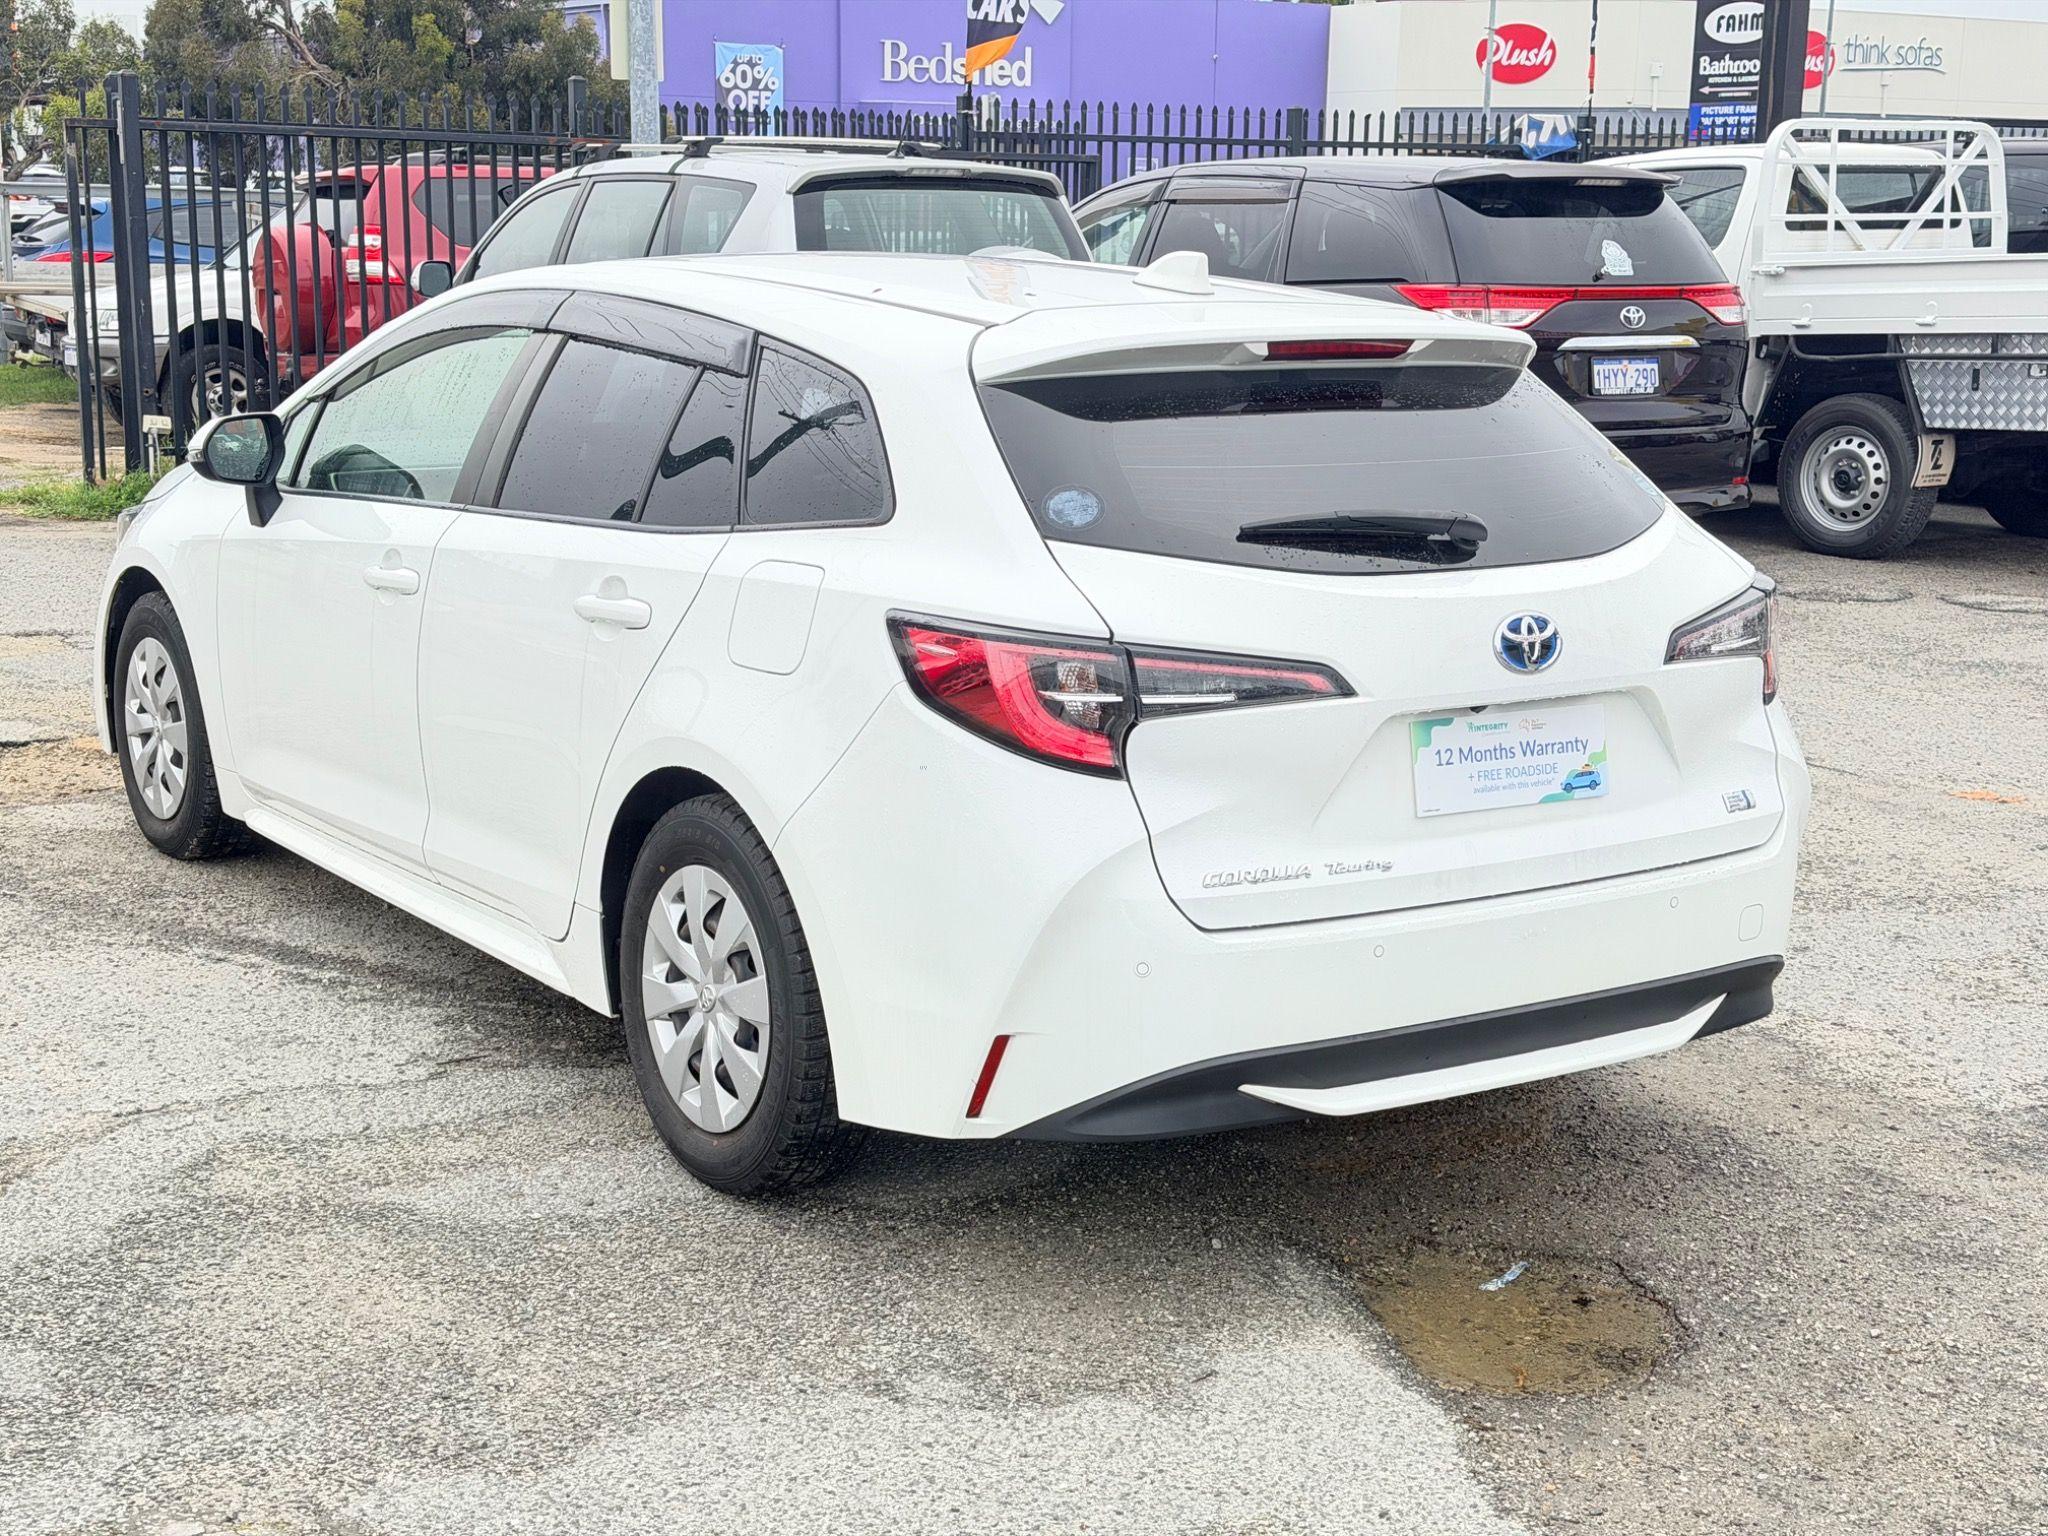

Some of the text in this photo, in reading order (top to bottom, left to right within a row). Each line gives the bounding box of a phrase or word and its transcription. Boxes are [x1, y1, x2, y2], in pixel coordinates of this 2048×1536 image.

[966, 0, 1030, 24] CARS
[736, 54, 764, 64] UP TO
[1481, 33, 1553, 74] Plush
[1843, 34, 1943, 67] think sofas
[720, 63, 780, 90] 60%
[727, 89, 772, 113] OFF
[1701, 106, 1735, 116] PICTURE
[1434, 736, 1589, 767] 12 Months Warranty
[1477, 768, 1502, 782] FREE
[1505, 763, 1559, 779] ROADSIDE
[1473, 781, 1500, 794] available
[1502, 780, 1517, 790] with
[1517, 778, 1533, 789] this
